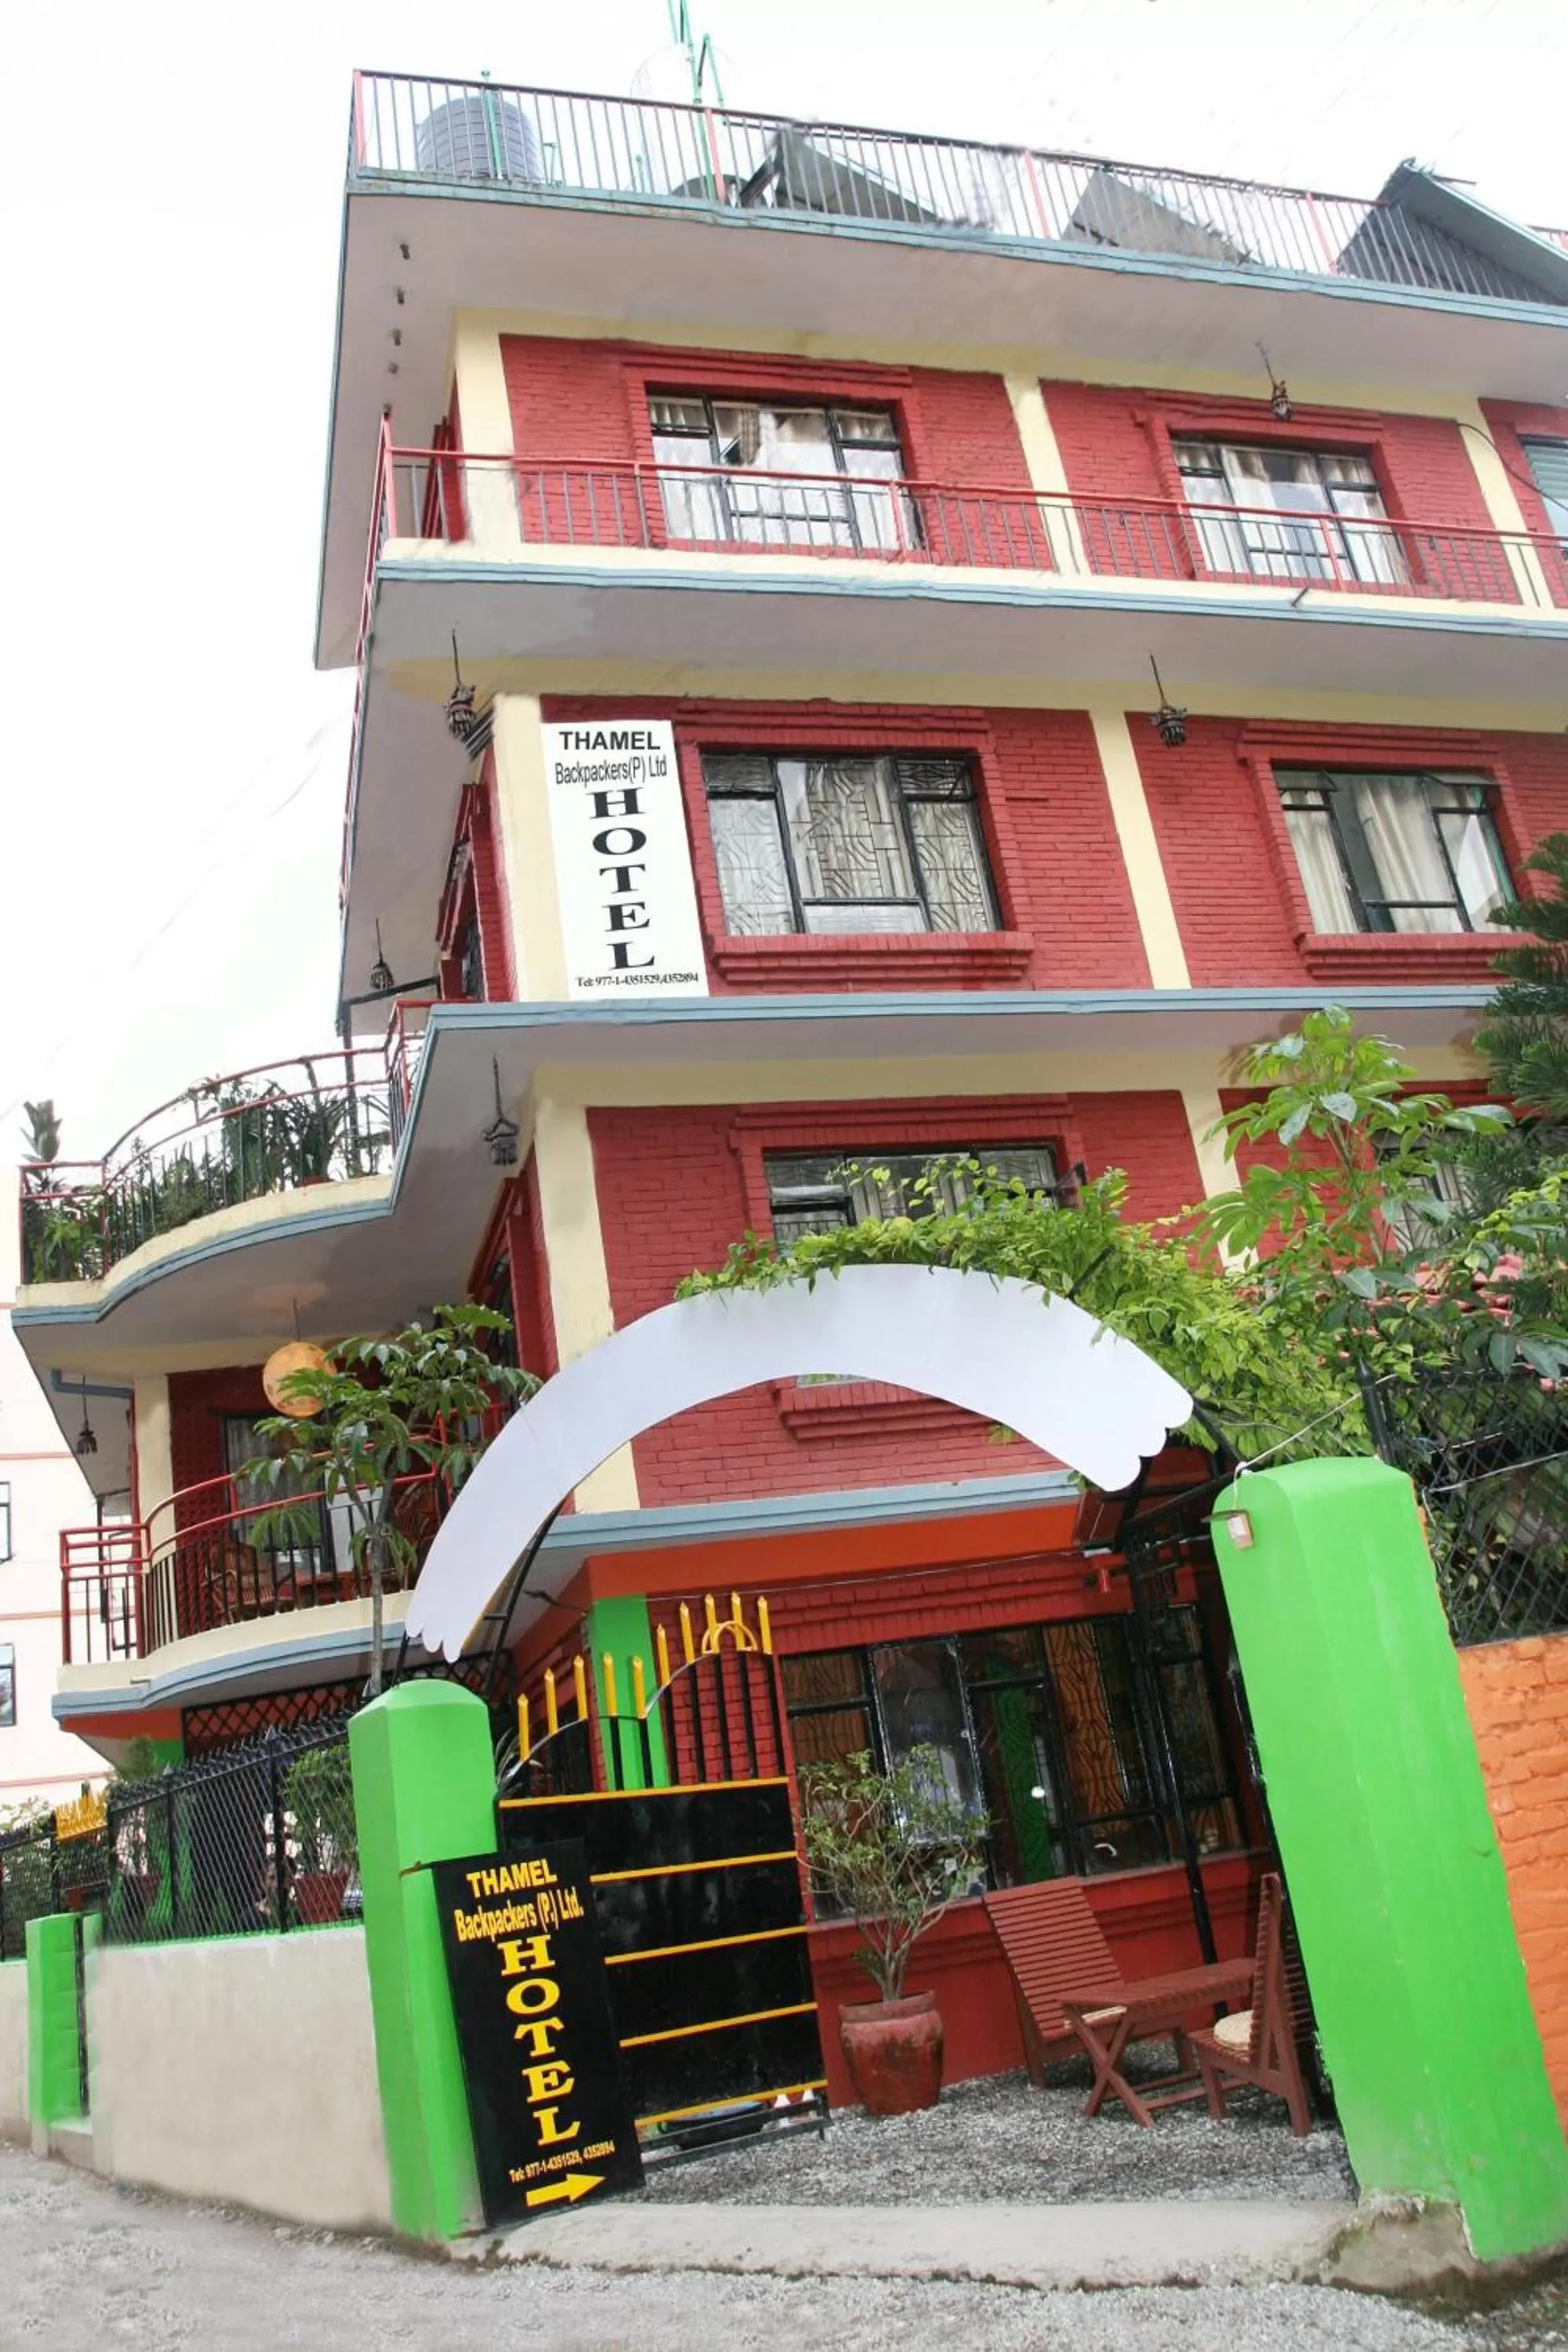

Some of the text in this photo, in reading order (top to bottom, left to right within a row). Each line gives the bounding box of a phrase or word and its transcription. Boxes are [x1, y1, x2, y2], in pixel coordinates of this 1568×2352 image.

[558, 731, 661, 750] THAMEL
[648, 753, 667, 778] Ltd
[586, 786, 655, 971] HOTEL
[466, 1858, 557, 1899] THAMEL
[454, 1898, 538, 1942] Backpackers
[556, 1885, 585, 1920] Ltd.
[496, 1933, 581, 2147] HOTEL
